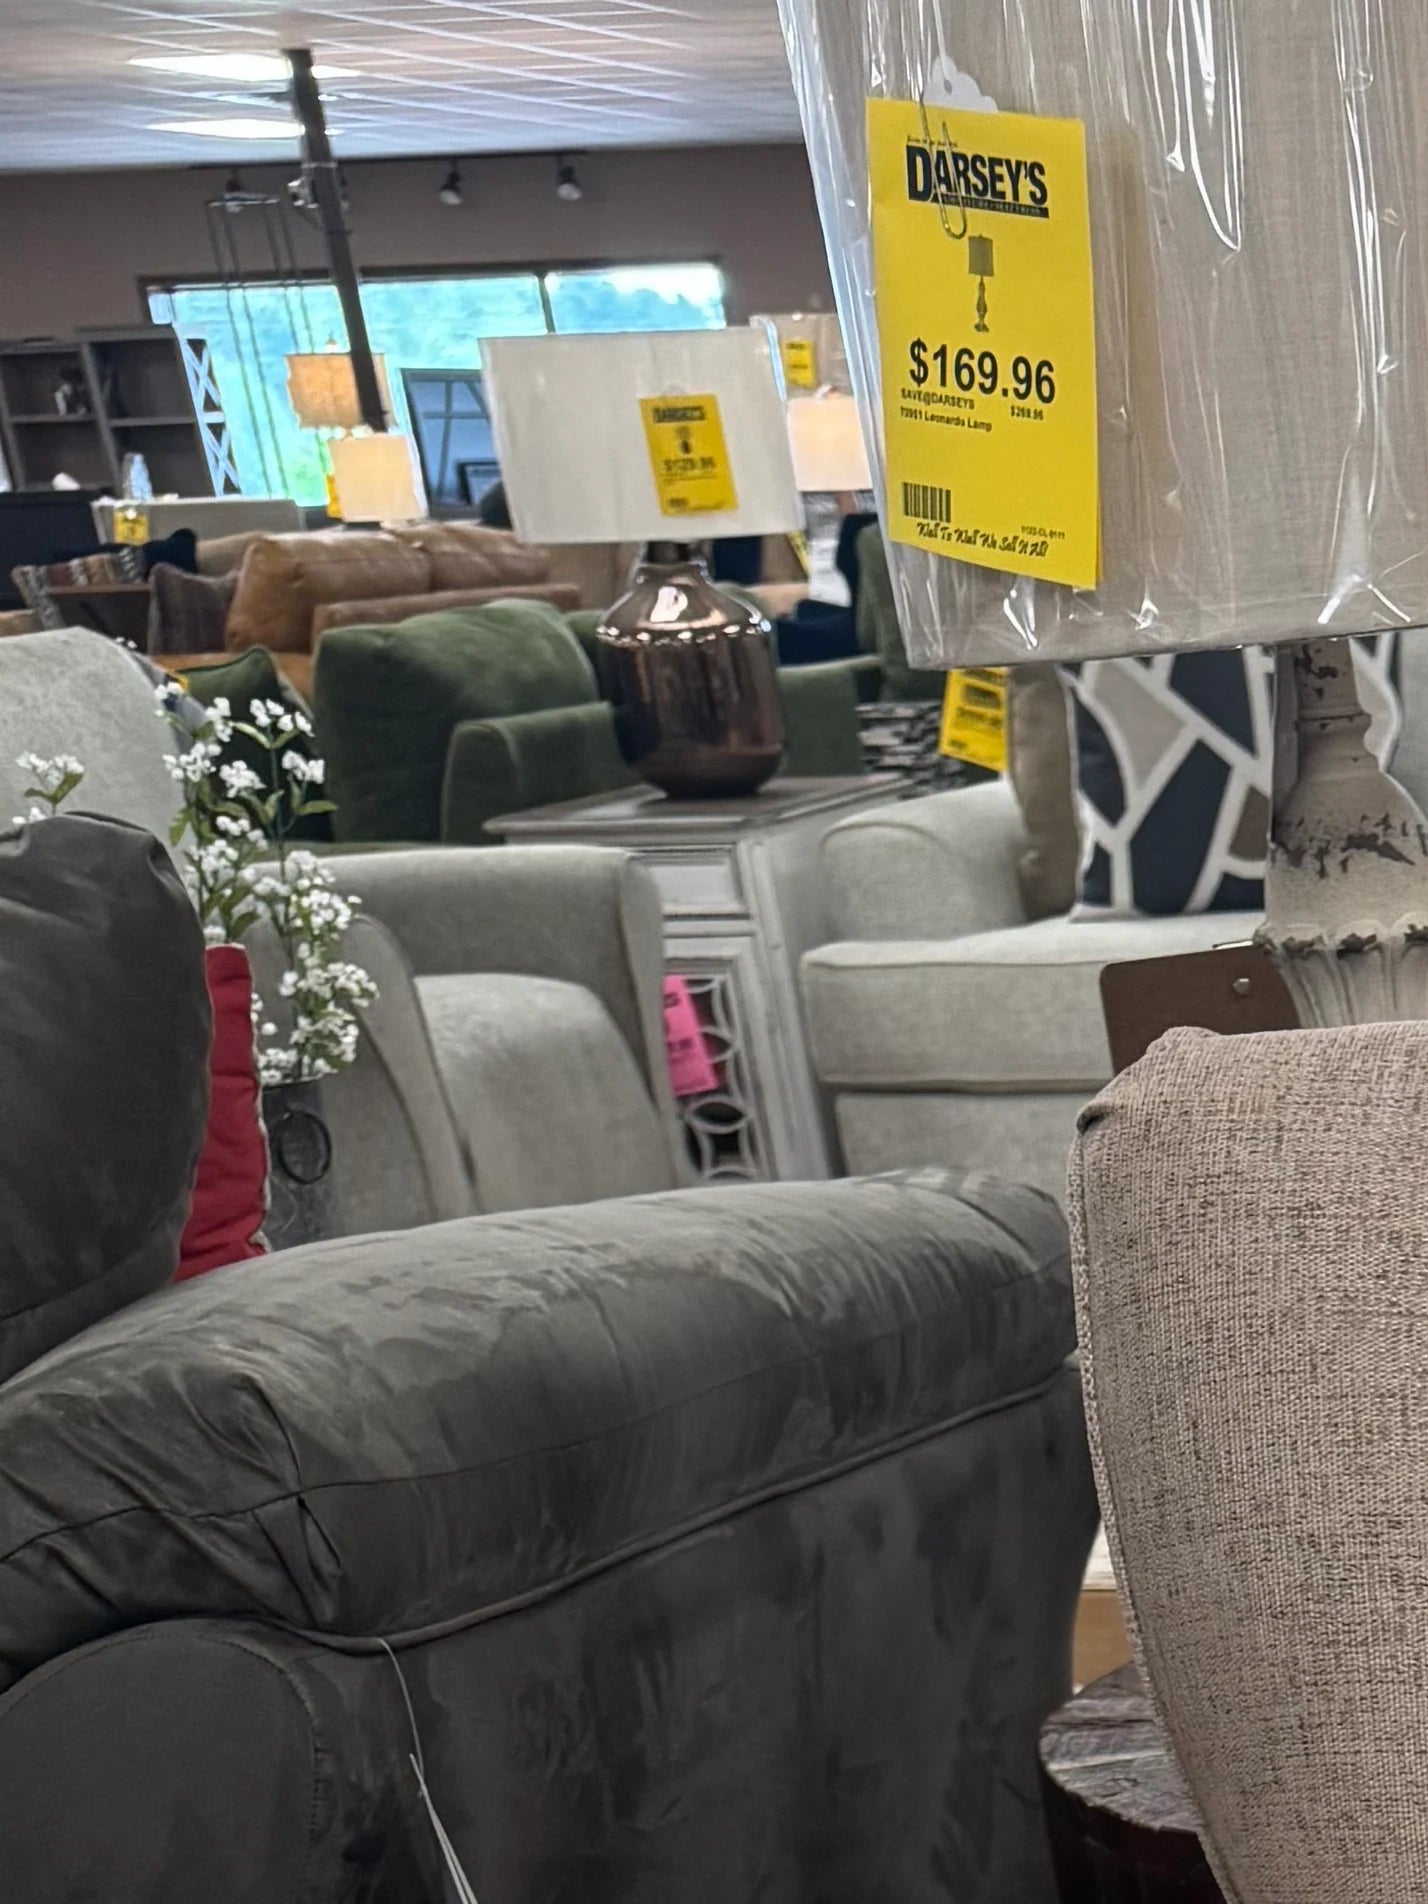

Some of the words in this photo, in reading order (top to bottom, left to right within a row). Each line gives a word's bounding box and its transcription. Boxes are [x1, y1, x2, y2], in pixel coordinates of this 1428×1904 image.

[906, 144, 1048, 205] DARSEY'S
[909, 337, 1056, 404] $169.96
[967, 417, 992, 432] Lamp
